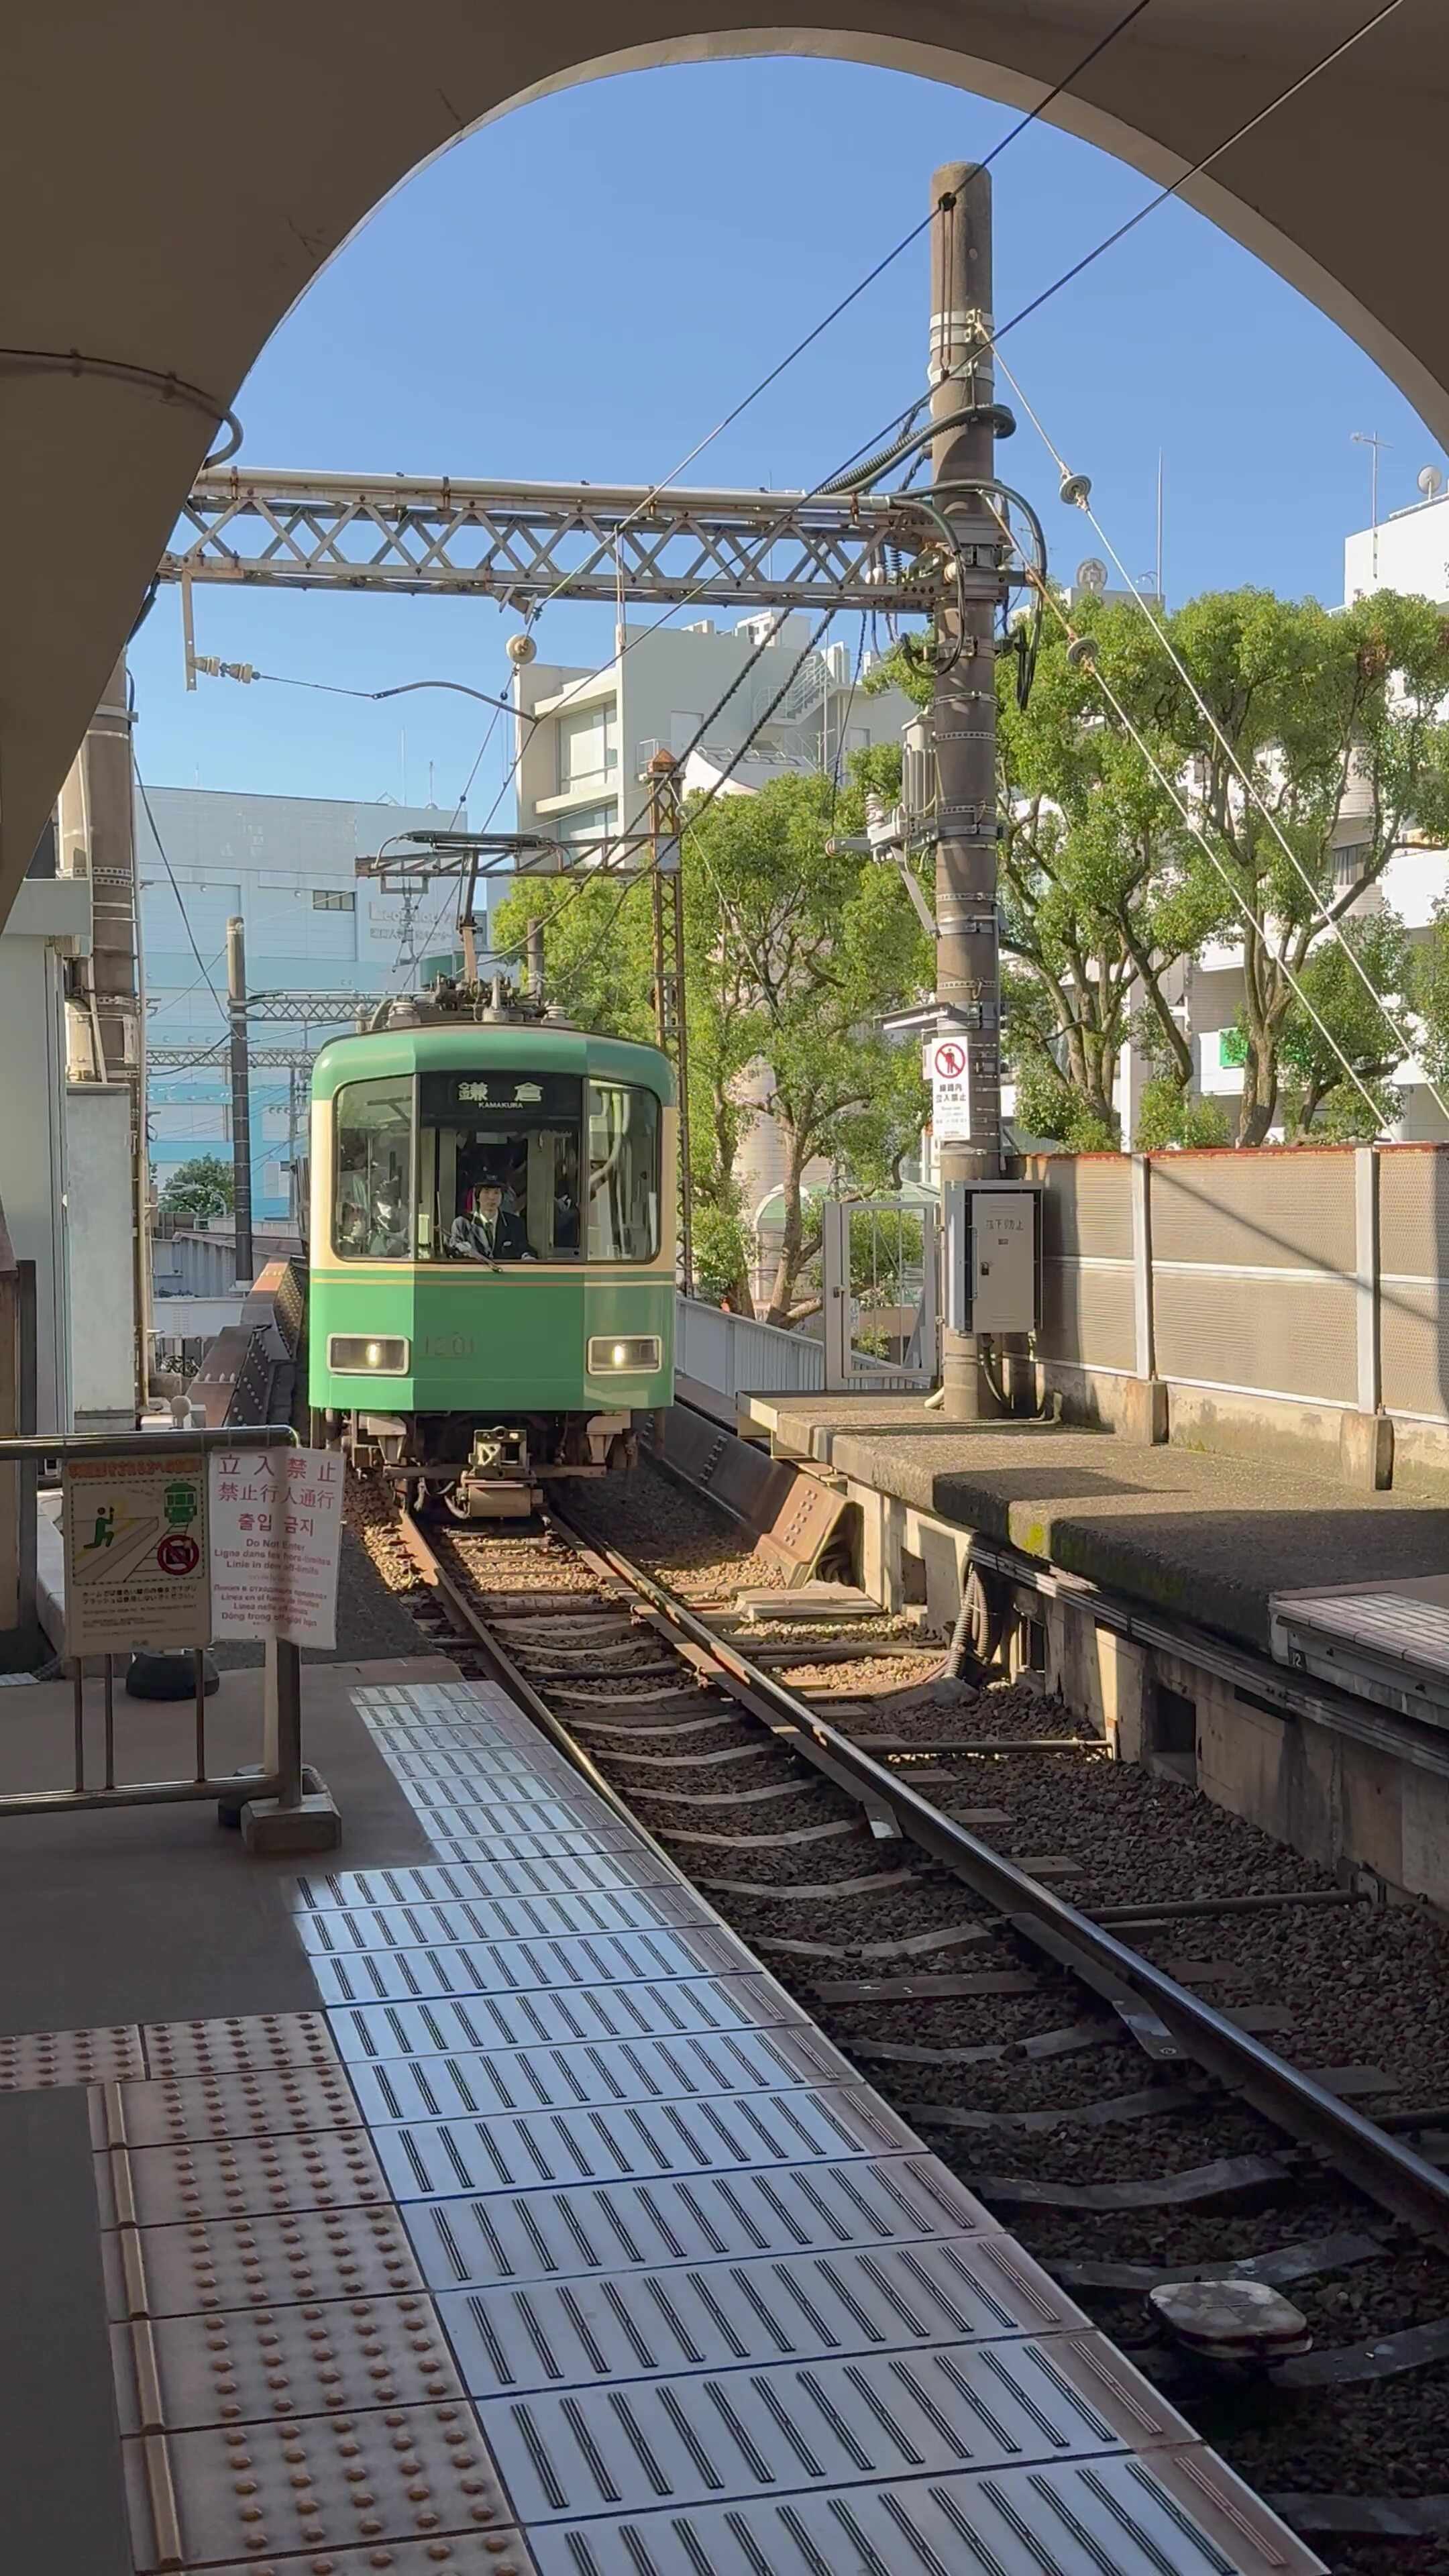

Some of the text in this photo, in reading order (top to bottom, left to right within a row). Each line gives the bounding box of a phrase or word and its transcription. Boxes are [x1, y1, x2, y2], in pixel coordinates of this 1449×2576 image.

[218, 1454, 337, 1483] 立入禁止
[218, 1481, 335, 1510] 禁止行人通行
[238, 1513, 314, 1537] 출입 금지
[246, 1538, 305, 1551] Do Not Enter
[242, 1550, 266, 1558] dans
[226, 1560, 250, 1568] Linie
[252, 1560, 262, 1568] in
